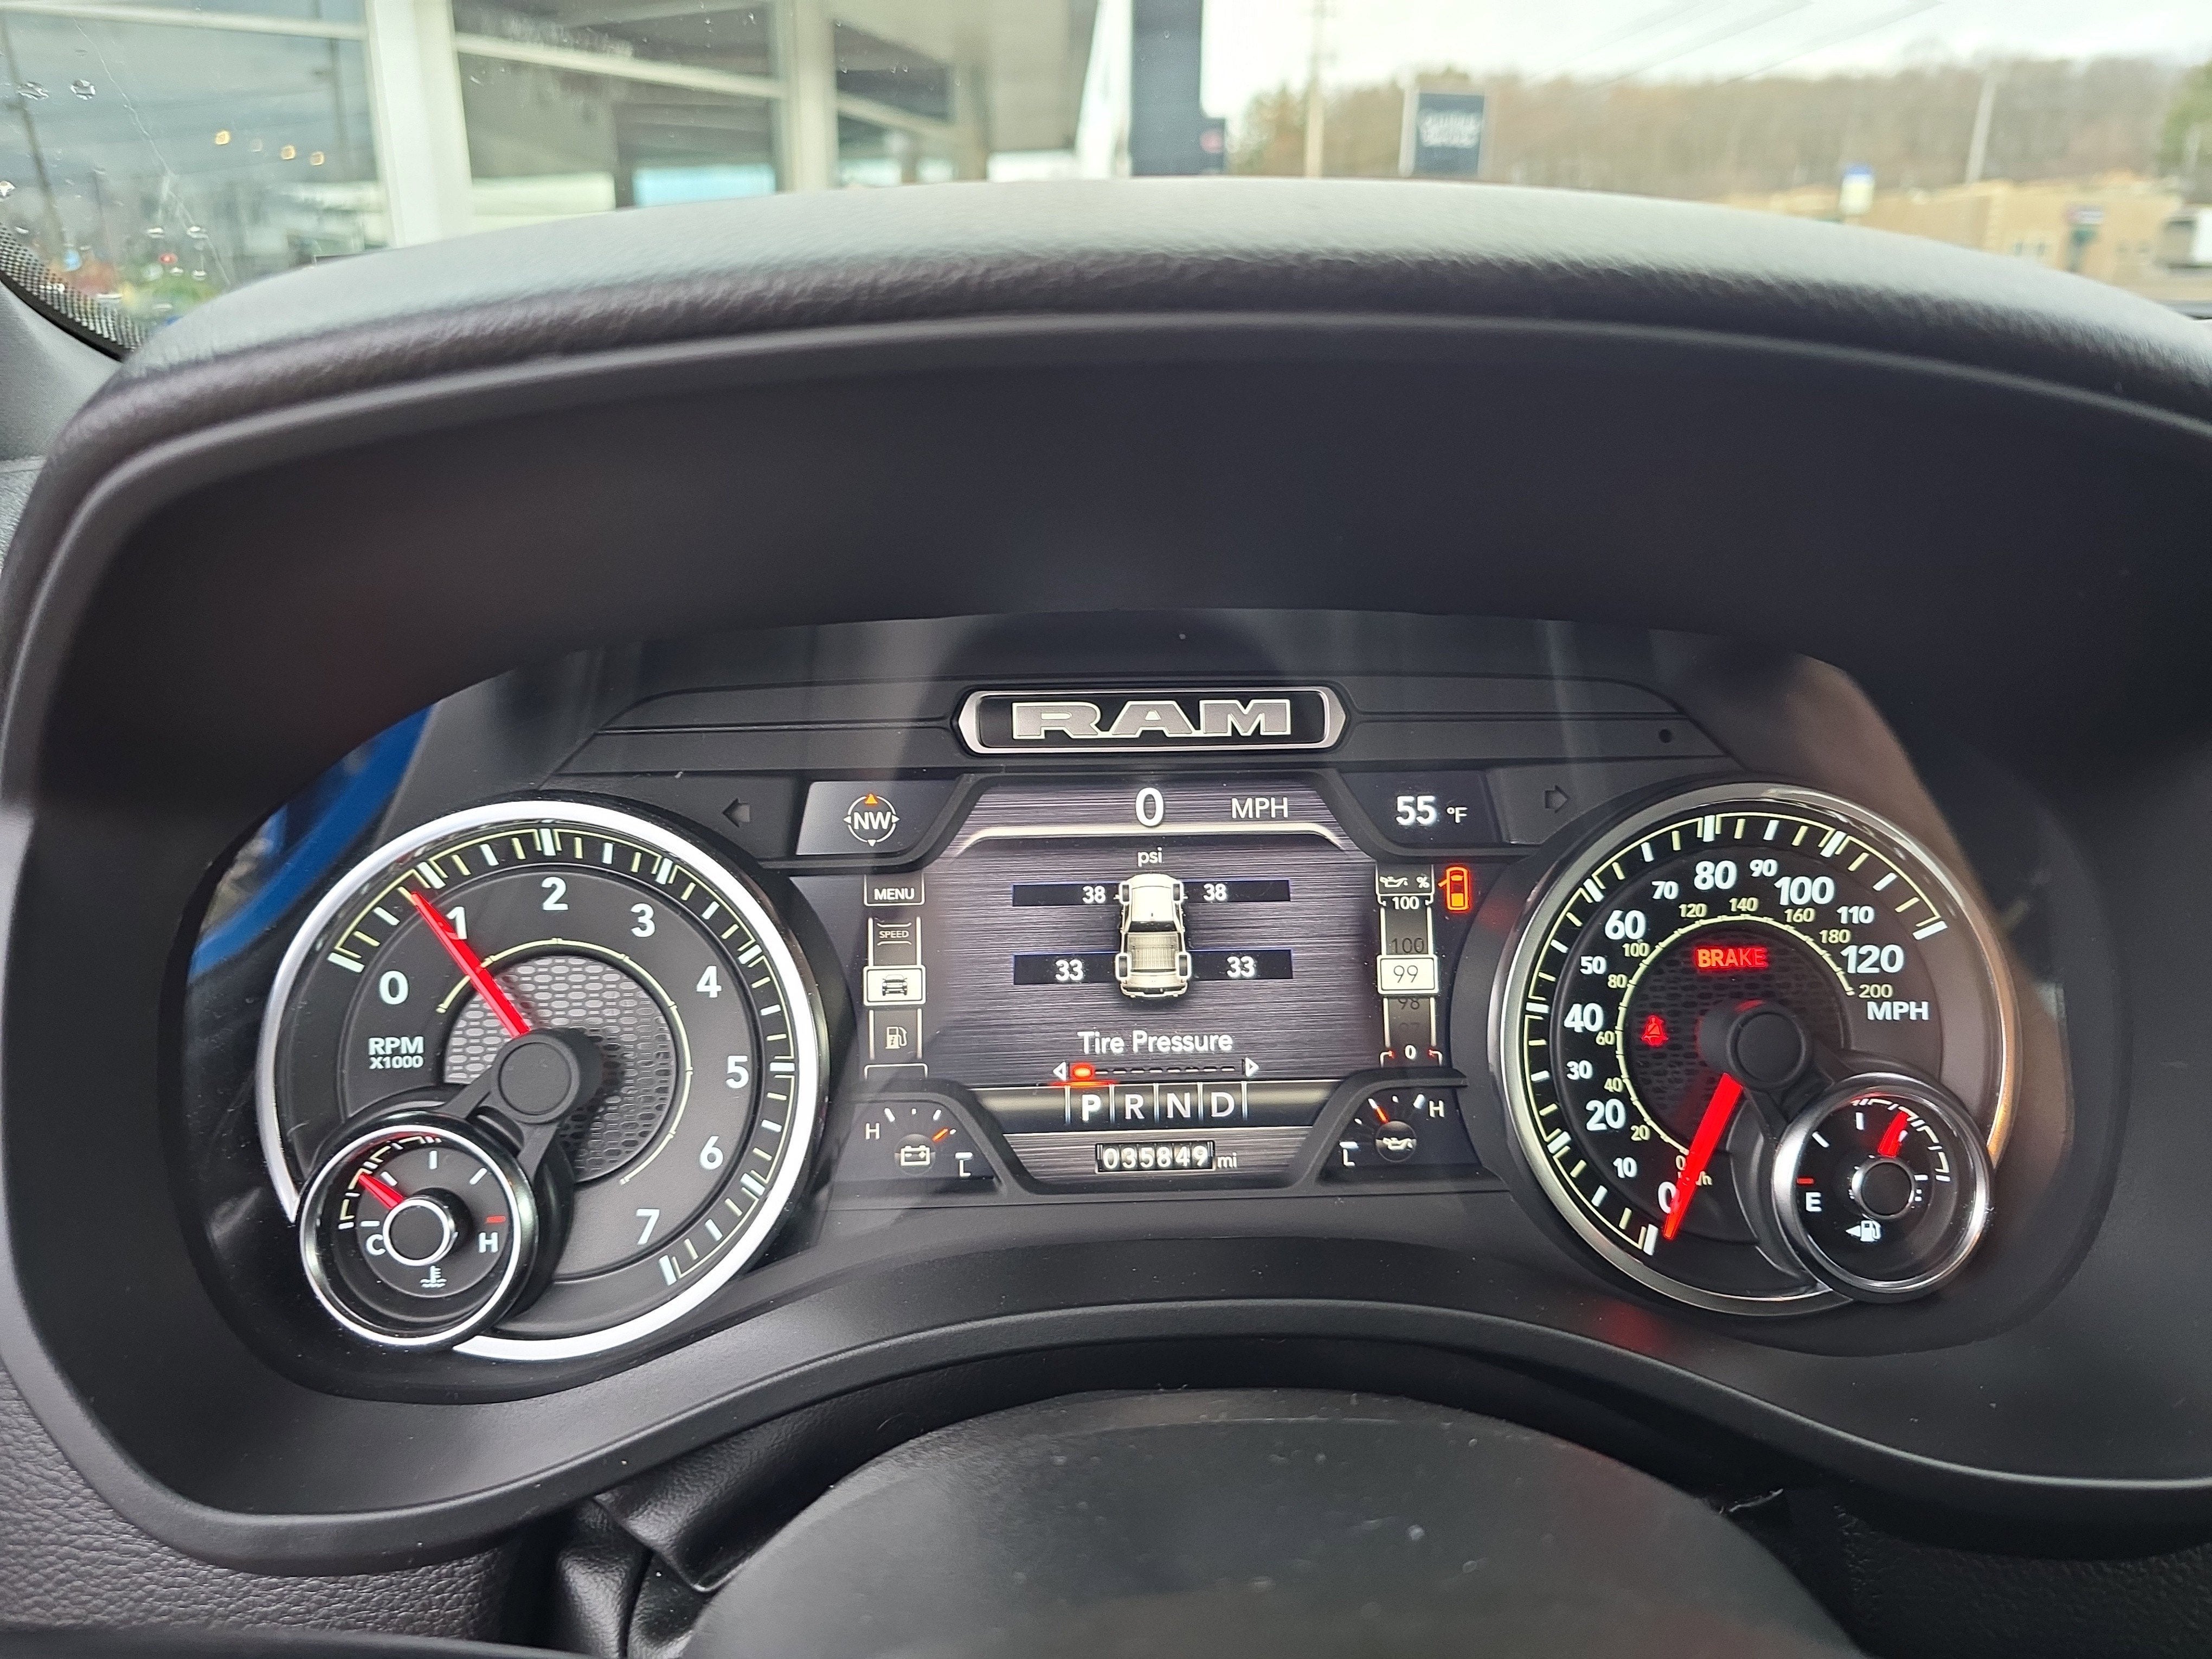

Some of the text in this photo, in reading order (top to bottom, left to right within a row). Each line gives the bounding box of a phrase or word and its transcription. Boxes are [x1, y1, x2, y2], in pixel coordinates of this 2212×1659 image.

[1012, 699, 1291, 740] RAM
[1135, 787, 1289, 827] 0 MPH
[1395, 796, 1438, 825] 55
[853, 812, 892, 831] NW
[1137, 847, 1163, 866] psi
[1694, 860, 1737, 890] 80
[1750, 859, 1778, 877] 90
[541, 877, 568, 911] 2
[874, 888, 915, 901] MENU
[1082, 886, 1106, 904] 38
[1203, 884, 1227, 902] 38
[1651, 880, 1679, 899] 70
[1774, 876, 1835, 905] 100
[1392, 896, 1419, 910] 100
[1679, 903, 1707, 917] 120
[1728, 897, 1759, 912] 140
[446, 906, 467, 940] 1
[630, 903, 656, 937] 3
[1784, 908, 1816, 922] 160
[1837, 905, 1874, 924] 110
[879, 930, 909, 938] SPEED
[1605, 910, 1647, 940] 60
[1819, 929, 1851, 943] 180
[1392, 938, 1424, 954] 100
[1622, 942, 1650, 957] 100
[1227, 956, 1255, 978] 33
[1580, 956, 1606, 974] 50
[1697, 949, 1767, 967] BRAKE
[1840, 944, 1904, 974] 120
[1055, 960, 1083, 981] 33
[1393, 965, 1418, 983] 99
[380, 970, 409, 1005] 0
[697, 966, 722, 998] 4
[1607, 974, 1626, 988] 80
[1859, 984, 1893, 998] 200
[1564, 1003, 1604, 1033] 40
[1867, 1001, 1928, 1020] MPH
[368, 1036, 424, 1055] RPM
[1077, 1030, 1233, 1054] Tire Pressure
[1596, 1030, 1616, 1045] 60
[1405, 1045, 1416, 1059] 0
[369, 1055, 423, 1069] X1000
[726, 1054, 748, 1088] 5
[1566, 1060, 1592, 1080] 30
[1604, 1077, 1624, 1092] 40
[1082, 1091, 1235, 1121] P R N D
[1429, 1101, 1445, 1117] H
[1586, 1098, 1625, 1130] 20
[865, 1123, 880, 1140] H
[1630, 1124, 1651, 1140] 20
[699, 1135, 723, 1169] 6
[1103, 1146, 1238, 1169] 035849 mi
[1343, 1149, 1356, 1166] L
[959, 1160, 972, 1177] L
[1613, 1157, 1637, 1178] 10
[1675, 1155, 1687, 1171] 0
[1658, 1181, 1680, 1214] 0
[1806, 1192, 1822, 1212] E
[636, 1209, 660, 1243] 7
[366, 1234, 386, 1255] C
[478, 1232, 498, 1253] H
